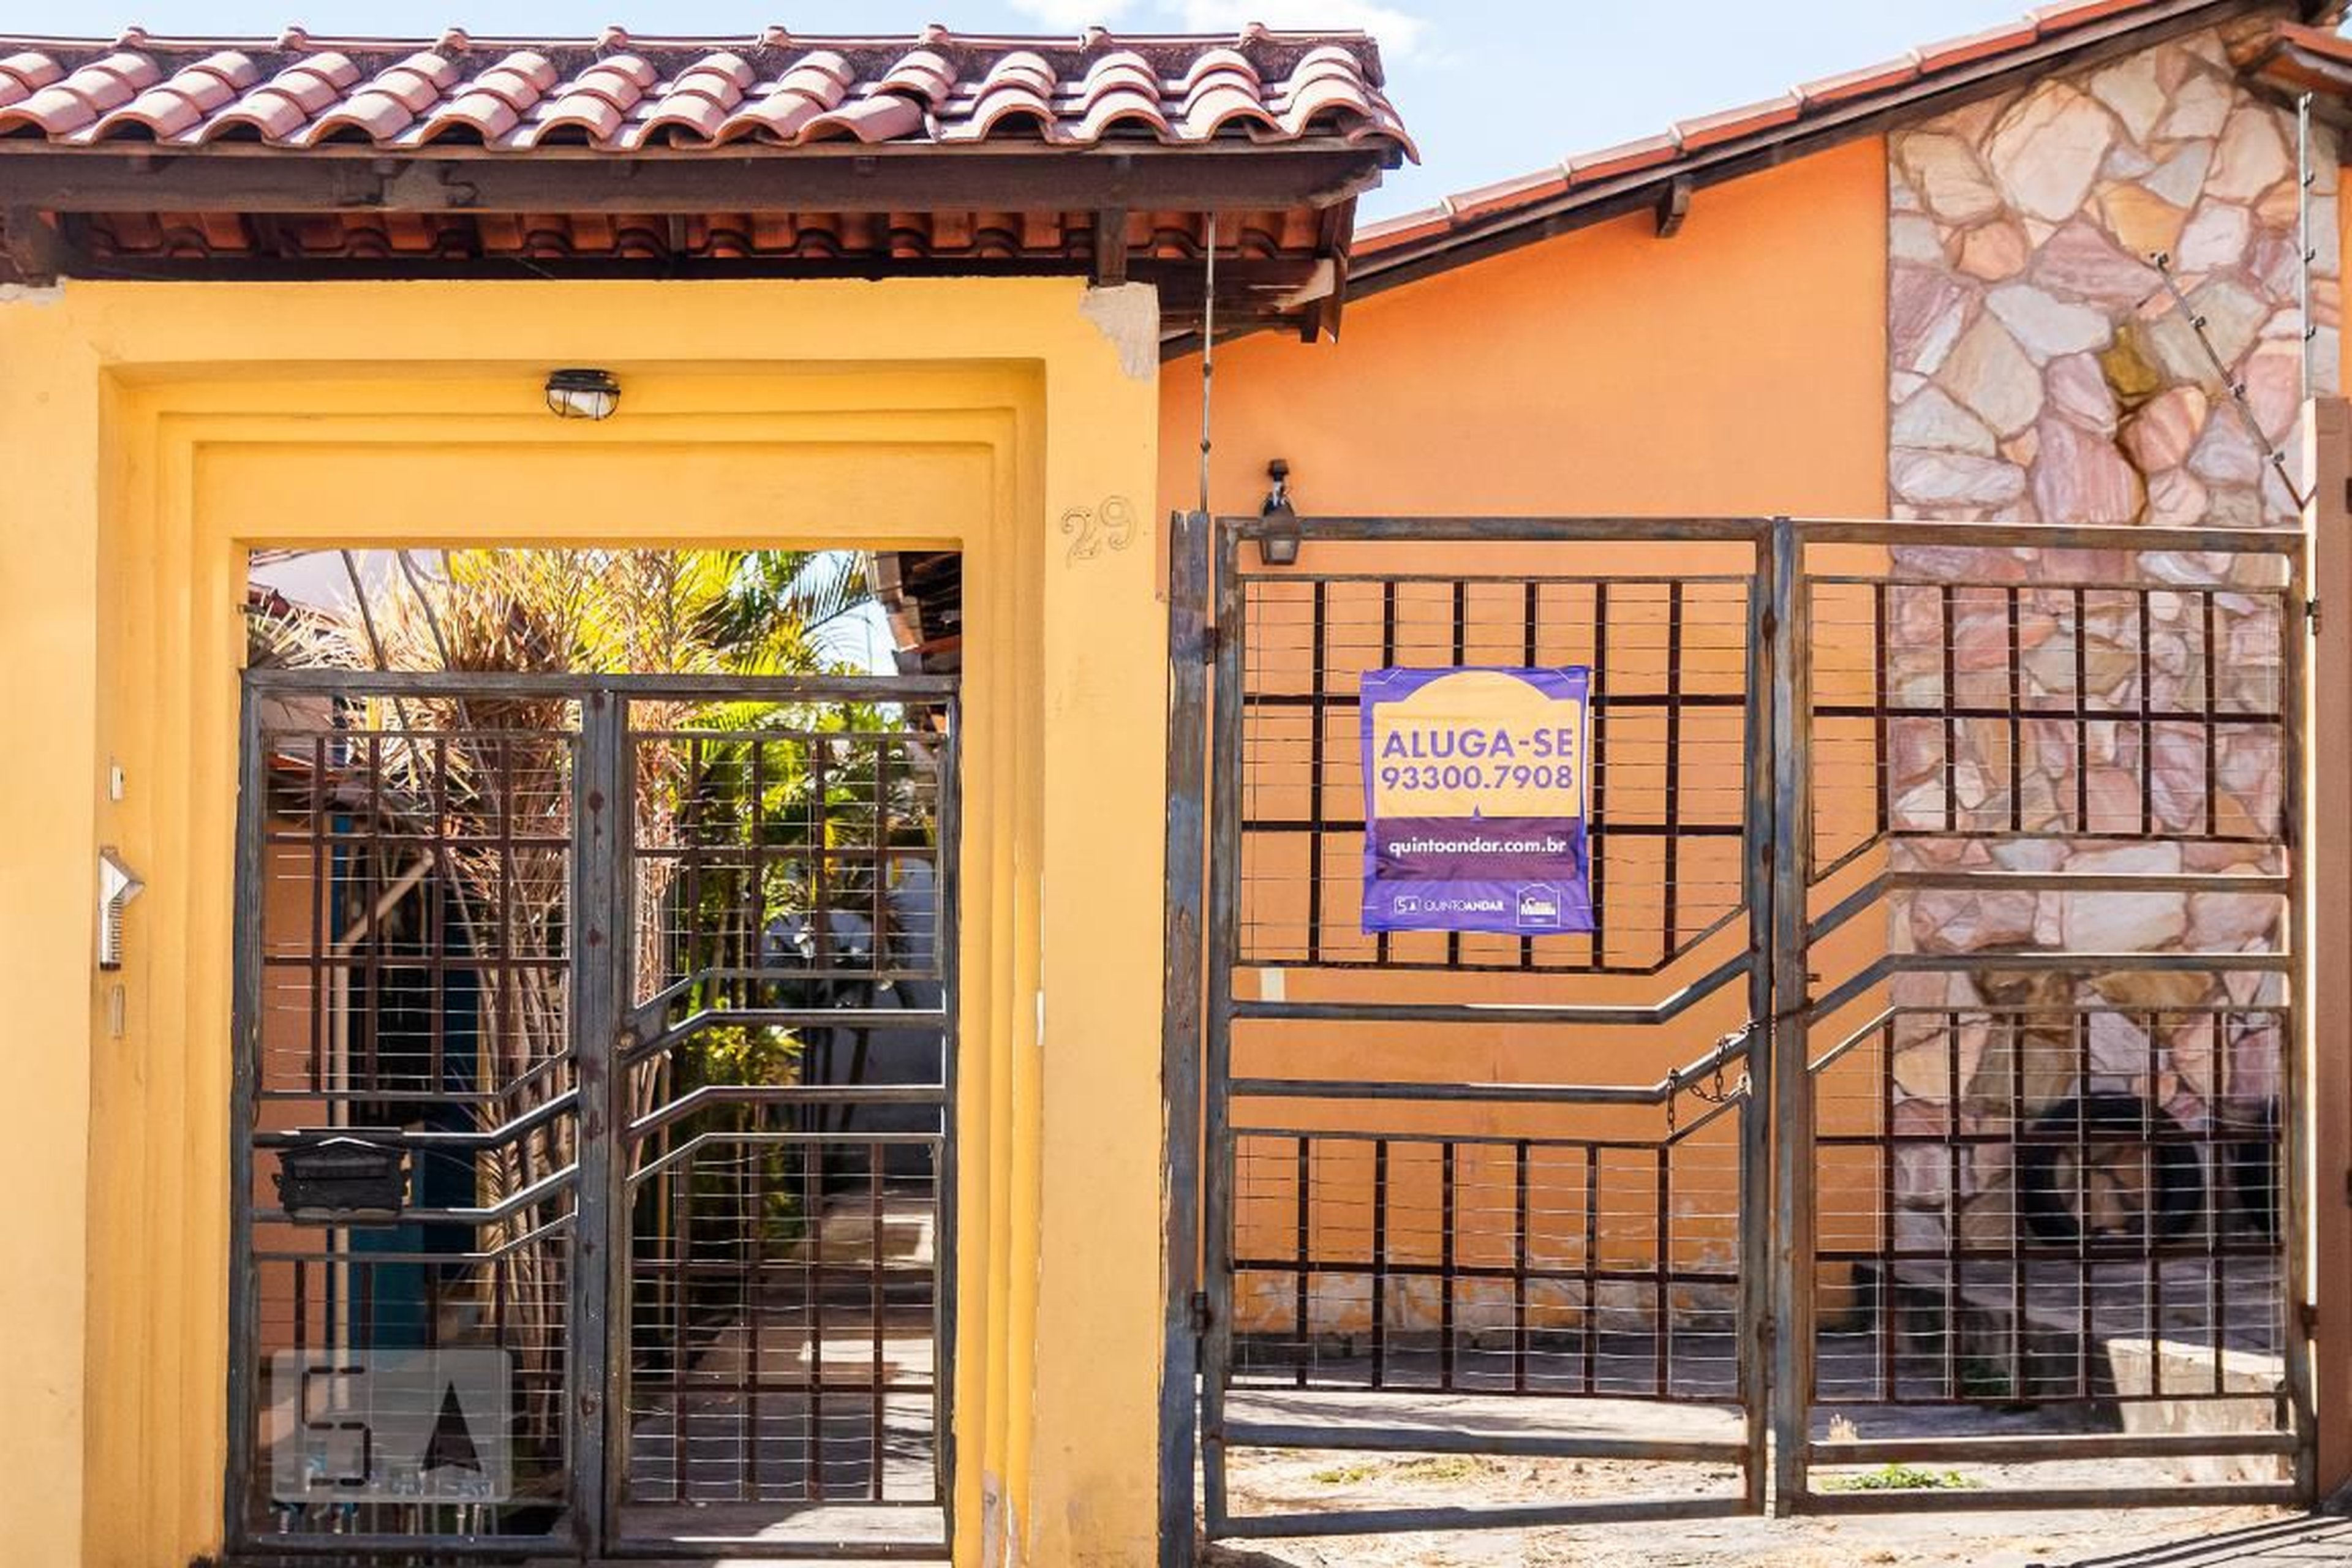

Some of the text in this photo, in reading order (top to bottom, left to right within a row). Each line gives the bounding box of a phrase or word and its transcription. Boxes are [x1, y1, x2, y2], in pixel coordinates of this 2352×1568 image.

[1060, 495, 1137, 570] 29
[1381, 728, 1573, 759] ALUGA-SE
[1381, 764, 1574, 790] 93300.7908
[1389, 837, 1567, 857] quintoandar.com.br
